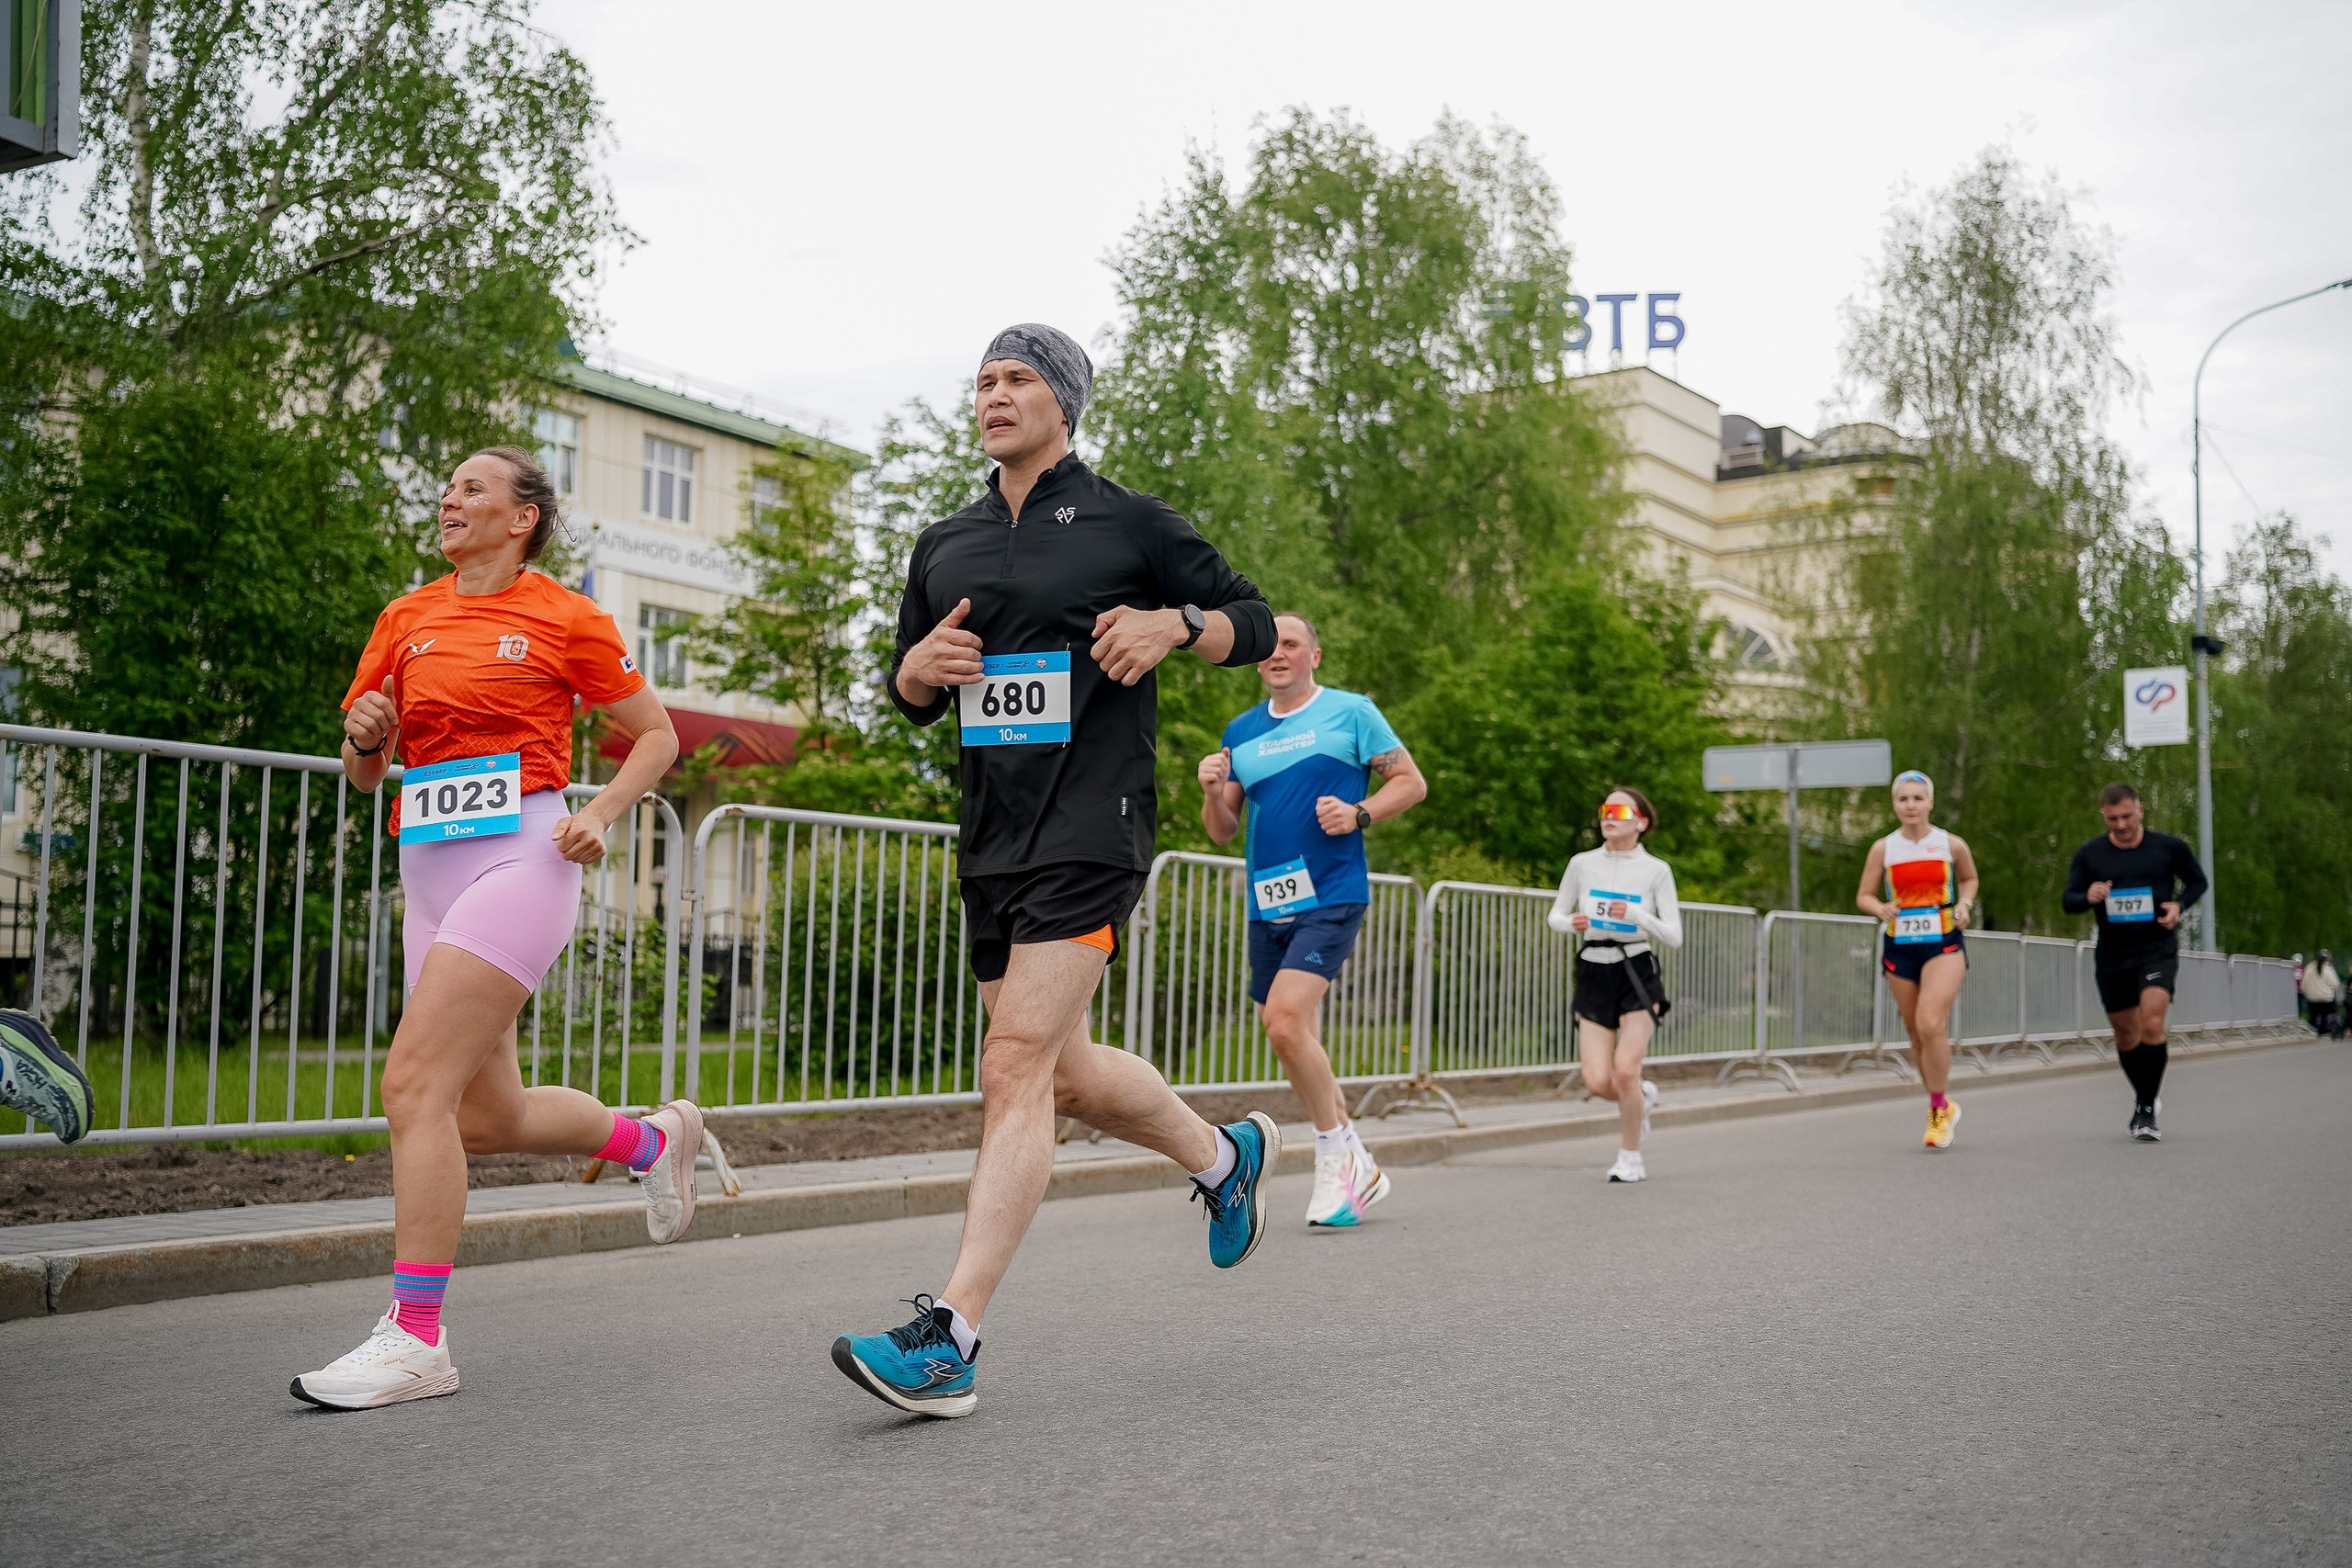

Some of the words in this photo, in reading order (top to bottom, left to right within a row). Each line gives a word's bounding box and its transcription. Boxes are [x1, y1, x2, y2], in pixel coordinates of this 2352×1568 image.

[981, 681, 1046, 717] 680
[414, 778, 508, 818] 1023
[1264, 878, 1296, 902] 939
[1903, 919, 1931, 931] 730
